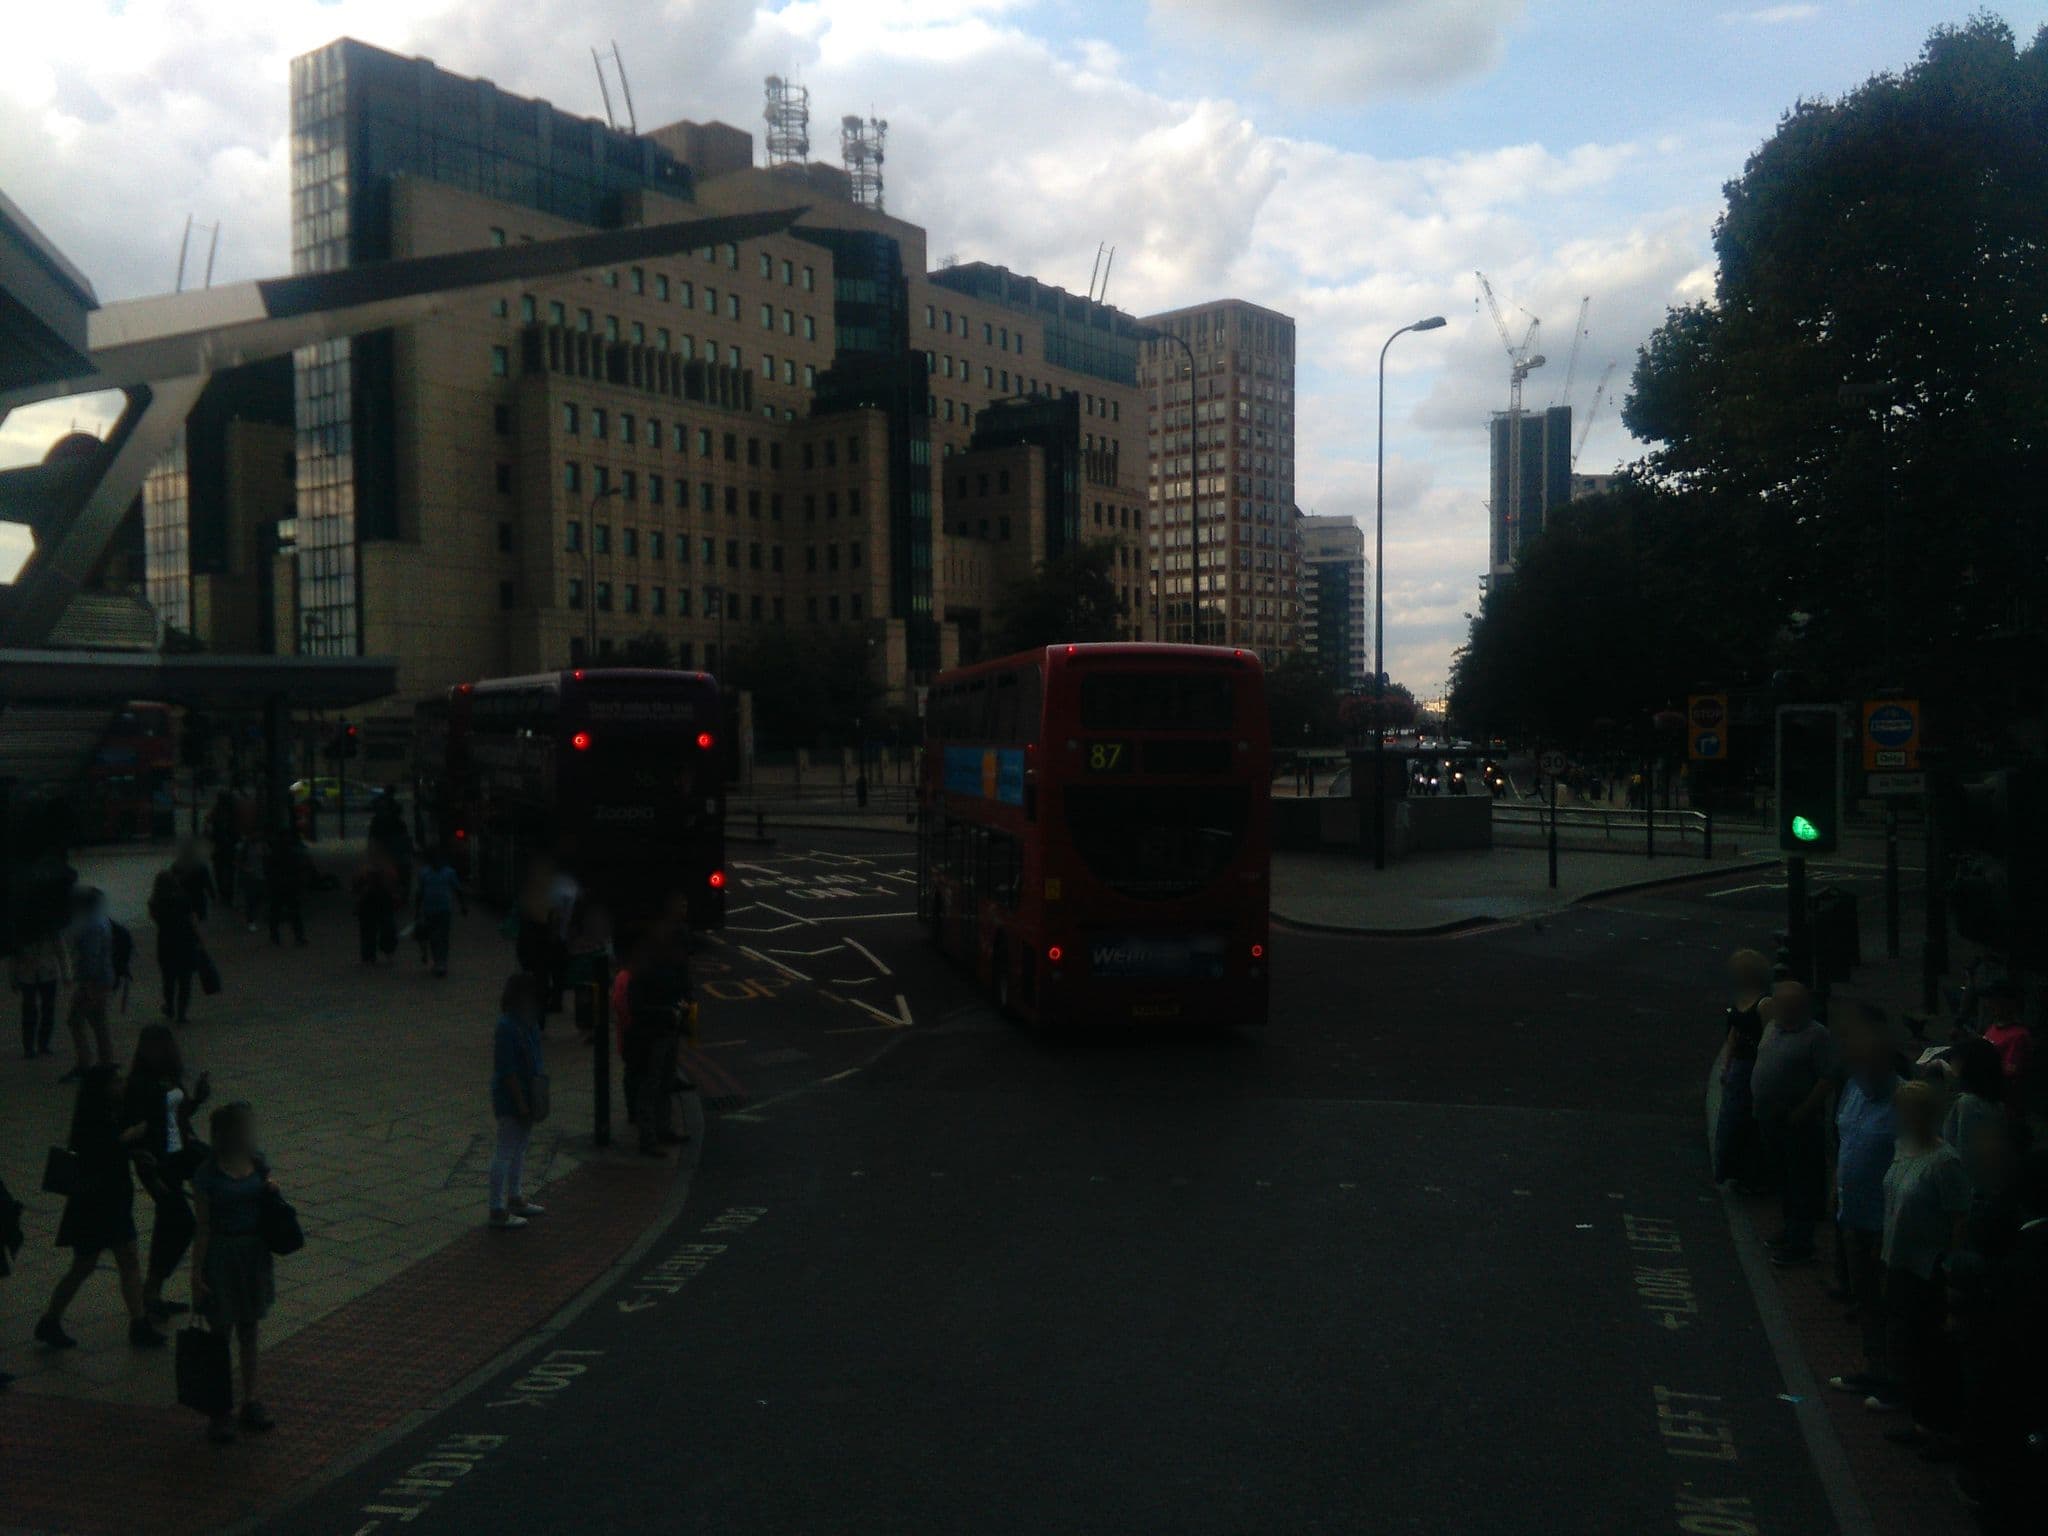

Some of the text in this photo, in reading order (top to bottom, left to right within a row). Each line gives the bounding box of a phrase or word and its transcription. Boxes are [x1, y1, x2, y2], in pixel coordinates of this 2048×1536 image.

[1089, 744, 1121, 768] 87
[1543, 756, 1563, 768] 30
[702, 977, 791, 999] OP
[1624, 1214, 1681, 1252] LEFT
[633, 1244, 728, 1293] RIGHT
[360, 1349, 605, 1522] LOOK RIGHT
[1653, 1385, 1760, 1536] OK LEFT
